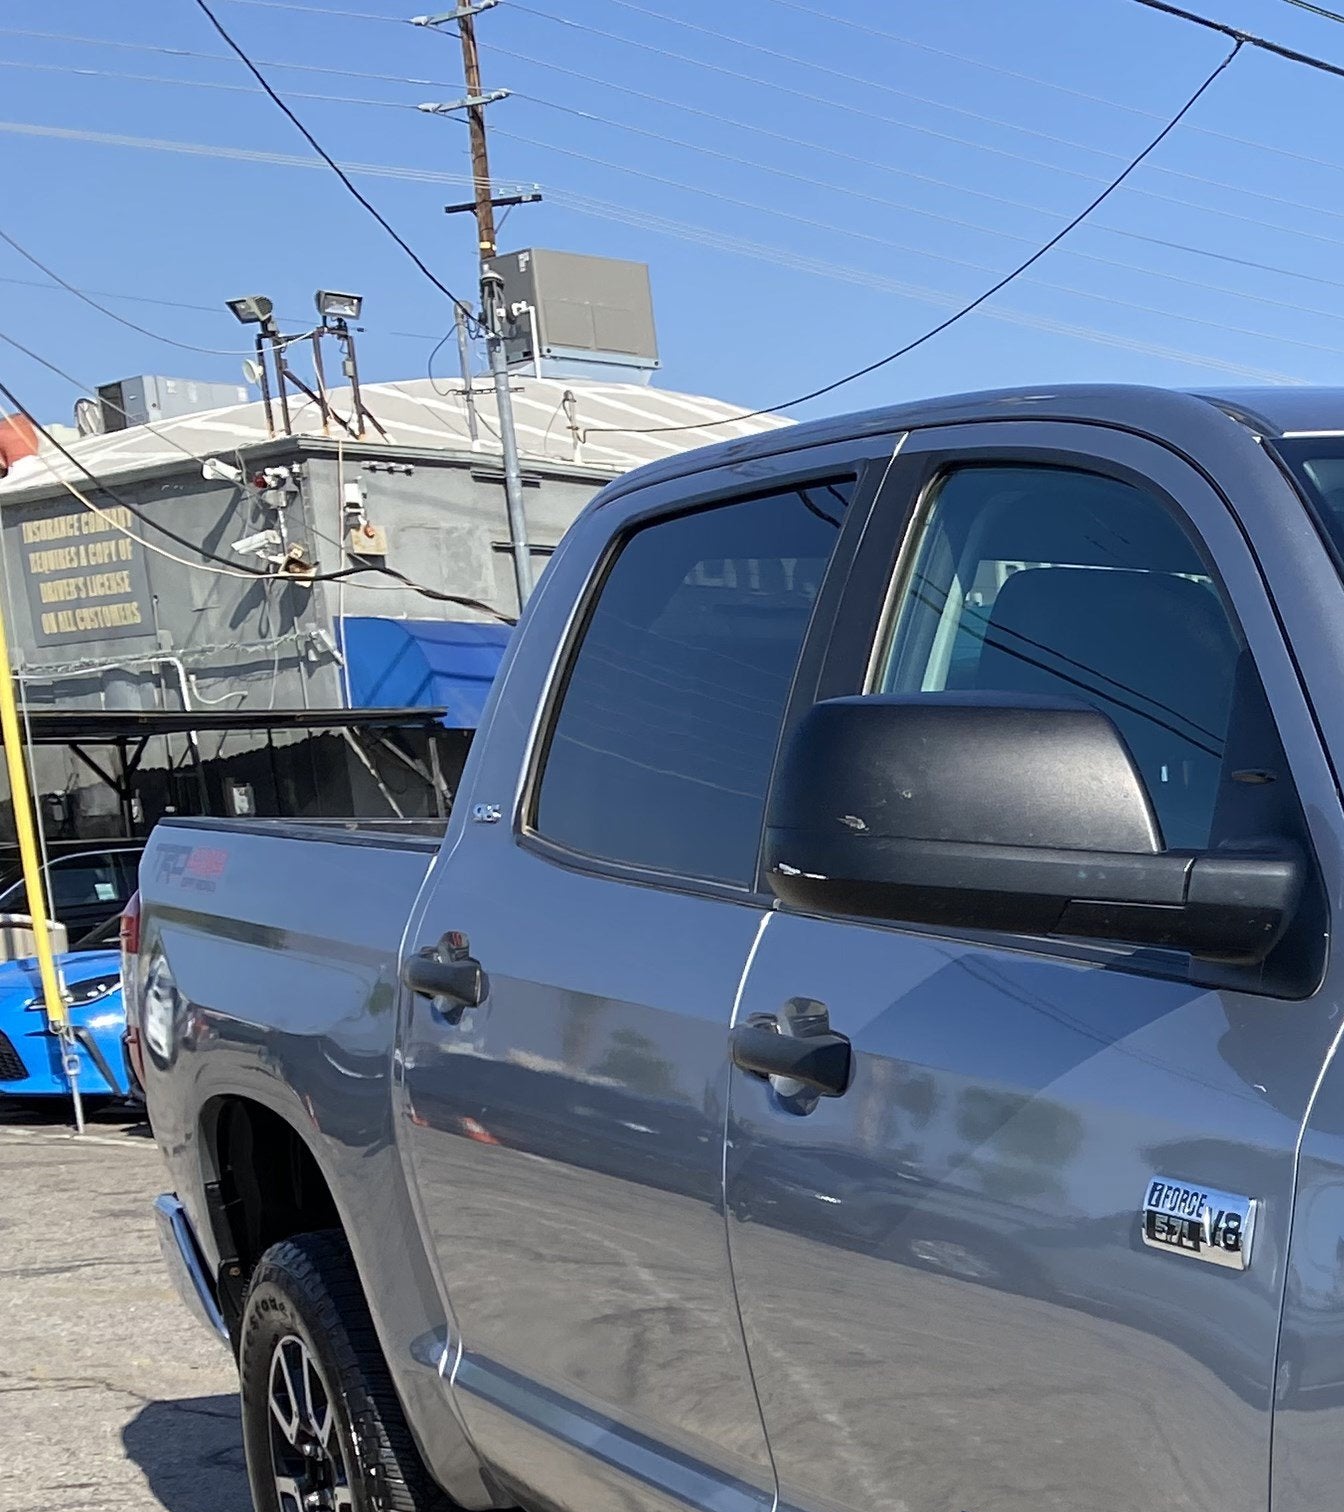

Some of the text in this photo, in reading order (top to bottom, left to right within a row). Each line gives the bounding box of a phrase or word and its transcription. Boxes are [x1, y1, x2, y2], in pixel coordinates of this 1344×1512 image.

[22, 505, 133, 544] INSURANCE COMPANY
[29, 537, 133, 574] REQUIRES A COPY OF
[40, 570, 132, 603] DRIVER'S LICENSE
[41, 602, 141, 635] ON ALL CUSTOMERS
[1204, 1204, 1243, 1253] V8
